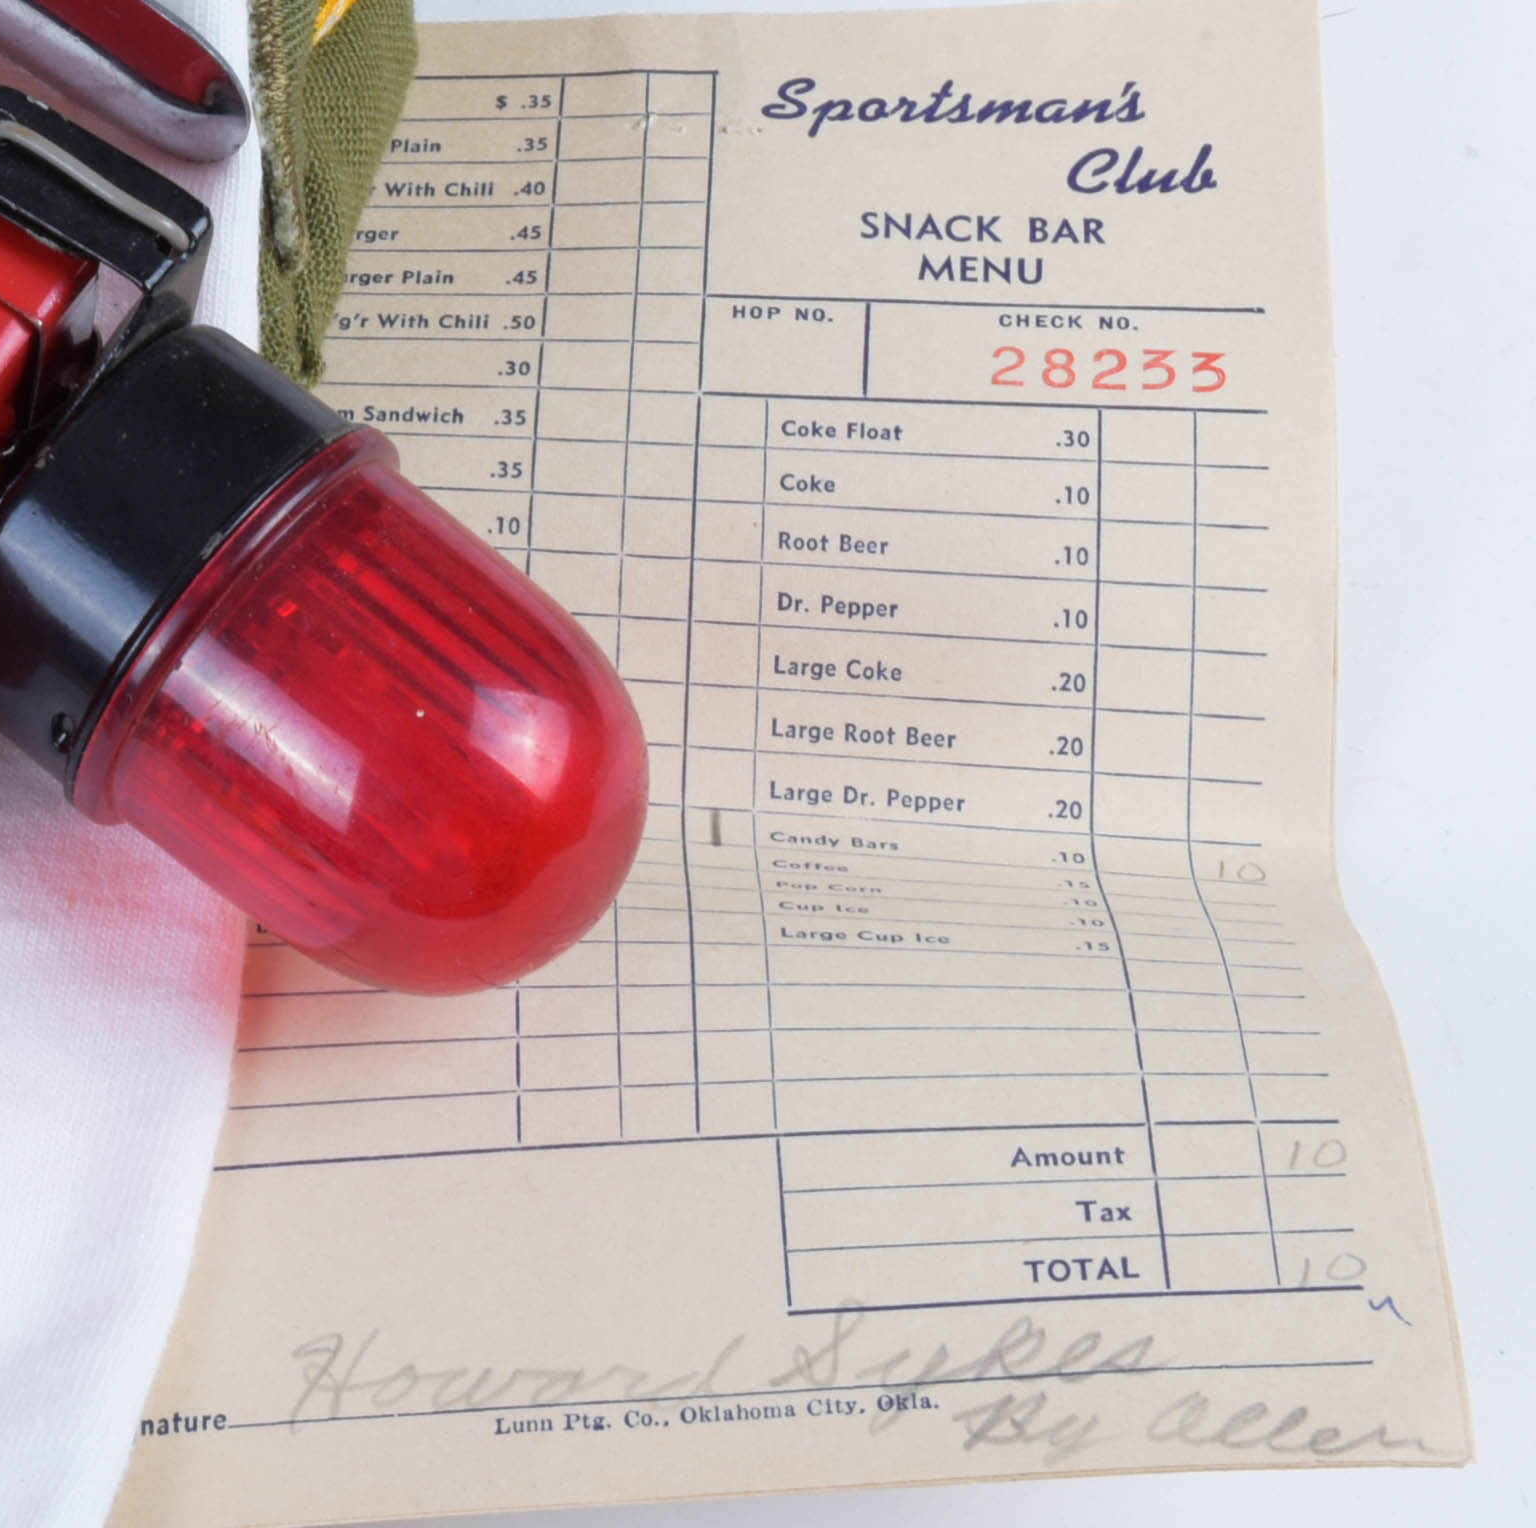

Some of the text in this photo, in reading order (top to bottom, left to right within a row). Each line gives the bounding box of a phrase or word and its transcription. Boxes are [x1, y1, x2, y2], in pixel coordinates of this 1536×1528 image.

[495, 94, 552, 110] $ .35
[760, 77, 1146, 138] Sportsman's
[390, 137, 548, 153] Plain .35
[1065, 143, 1218, 195] Club
[384, 182, 436, 197] With
[444, 182, 494, 197] Chili
[513, 181, 546, 197] .40
[356, 225, 542, 243] rger .45
[859, 211, 1106, 245] SNACK BAR
[343, 270, 538, 287] rger Plain .45
[917, 254, 1044, 286] MENU
[377, 313, 429, 329] With
[438, 314, 490, 330] Chili
[503, 315, 536, 330] .50
[731, 304, 835, 323] HOP NO.
[998, 313, 1140, 332] CHECK NO.
[497, 360, 531, 376] .30
[989, 344, 1228, 394] 28233
[363, 405, 465, 424] Sandwich
[494, 409, 527, 426] .35
[781, 418, 1090, 449] Coke Float .30
[490, 461, 523, 479] .35
[779, 473, 1090, 506] Coke .10
[487, 516, 521, 535] .10
[777, 531, 1089, 566] Root Beer .10
[776, 591, 1088, 630] Dr. Pepper .10
[773, 654, 1086, 693] Large Coke .20
[771, 718, 1084, 758] Large Root Beer .20
[769, 781, 1083, 821] Large Dr. Pepper .20
[769, 831, 1085, 865] Candy Bars .10
[772, 859, 849, 872] Coffee
[776, 879, 818, 891] Pop
[828, 883, 883, 894] Corn
[778, 900, 825, 914] Cup
[835, 904, 870, 915] Ice
[780, 926, 848, 942] Large
[857, 930, 904, 944] Cup
[915, 933, 952, 944] Ice
[1009, 1145, 1126, 1169] Amount
[1076, 1200, 1133, 1224] Tax
[1023, 1256, 1141, 1283] TOTAL
[140, 1409, 228, 1437] nature
[493, 1415, 539, 1435] Lunn
[561, 1412, 612, 1434] Ptg.
[679, 1400, 796, 1425] Oklahoma
[876, 1391, 940, 1413] Okla.
